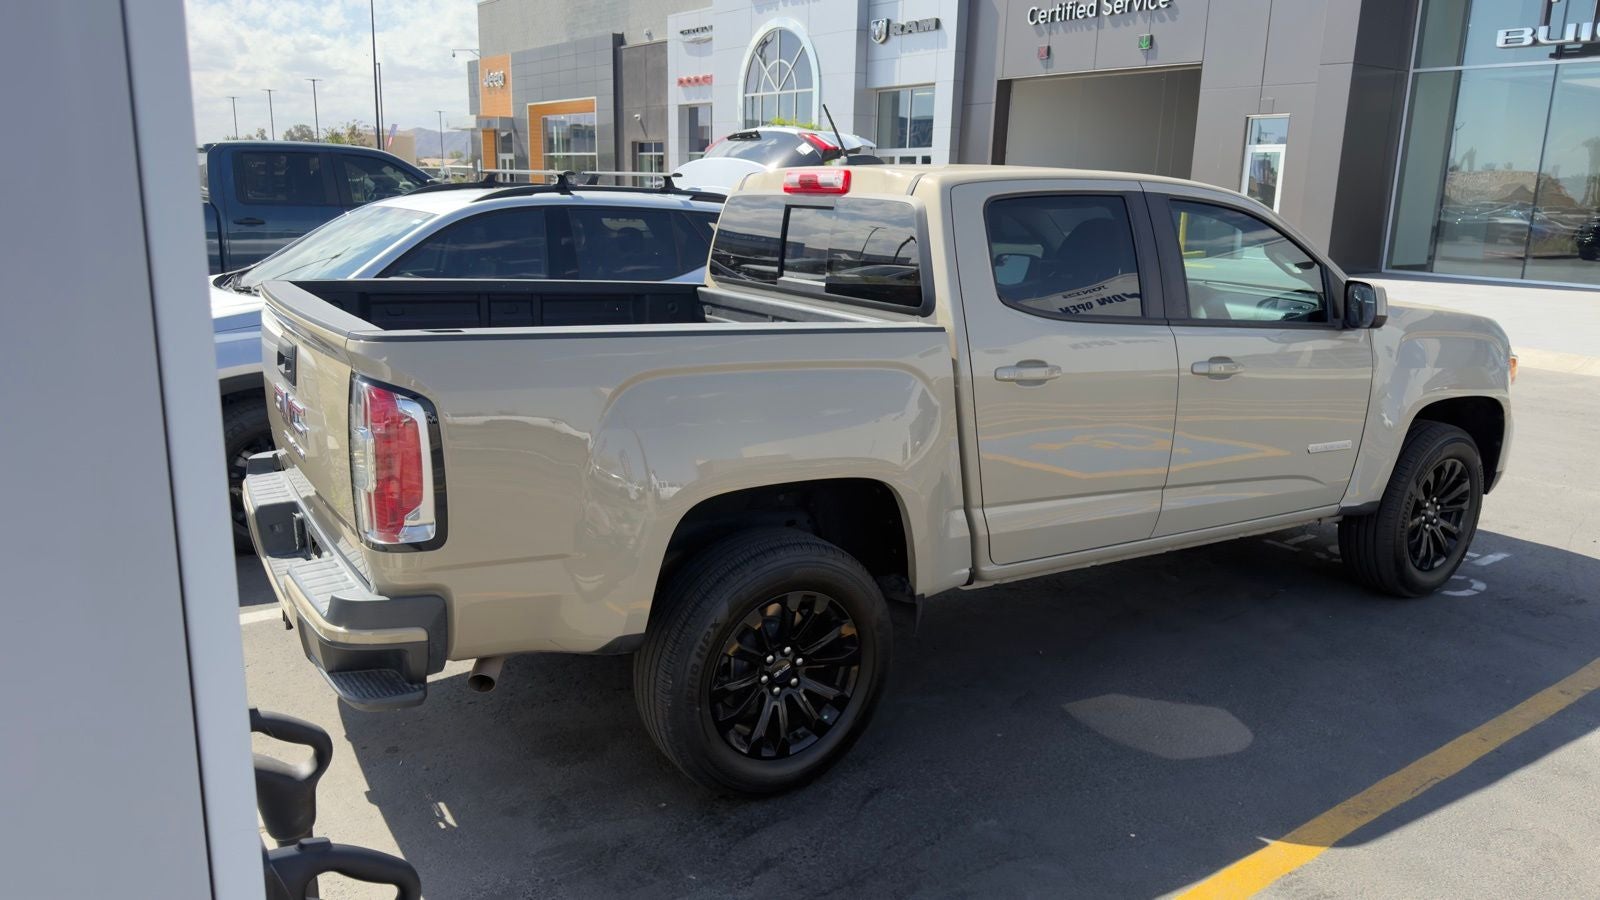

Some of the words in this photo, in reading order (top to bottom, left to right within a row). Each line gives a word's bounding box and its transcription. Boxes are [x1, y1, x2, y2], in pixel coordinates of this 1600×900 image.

[1027, 0, 1097, 25] Certified
[1102, 0, 1169, 16] Service
[889, 17, 940, 36] RAM
[1496, 22, 1600, 48] BUI
[483, 68, 505, 88] Jeep
